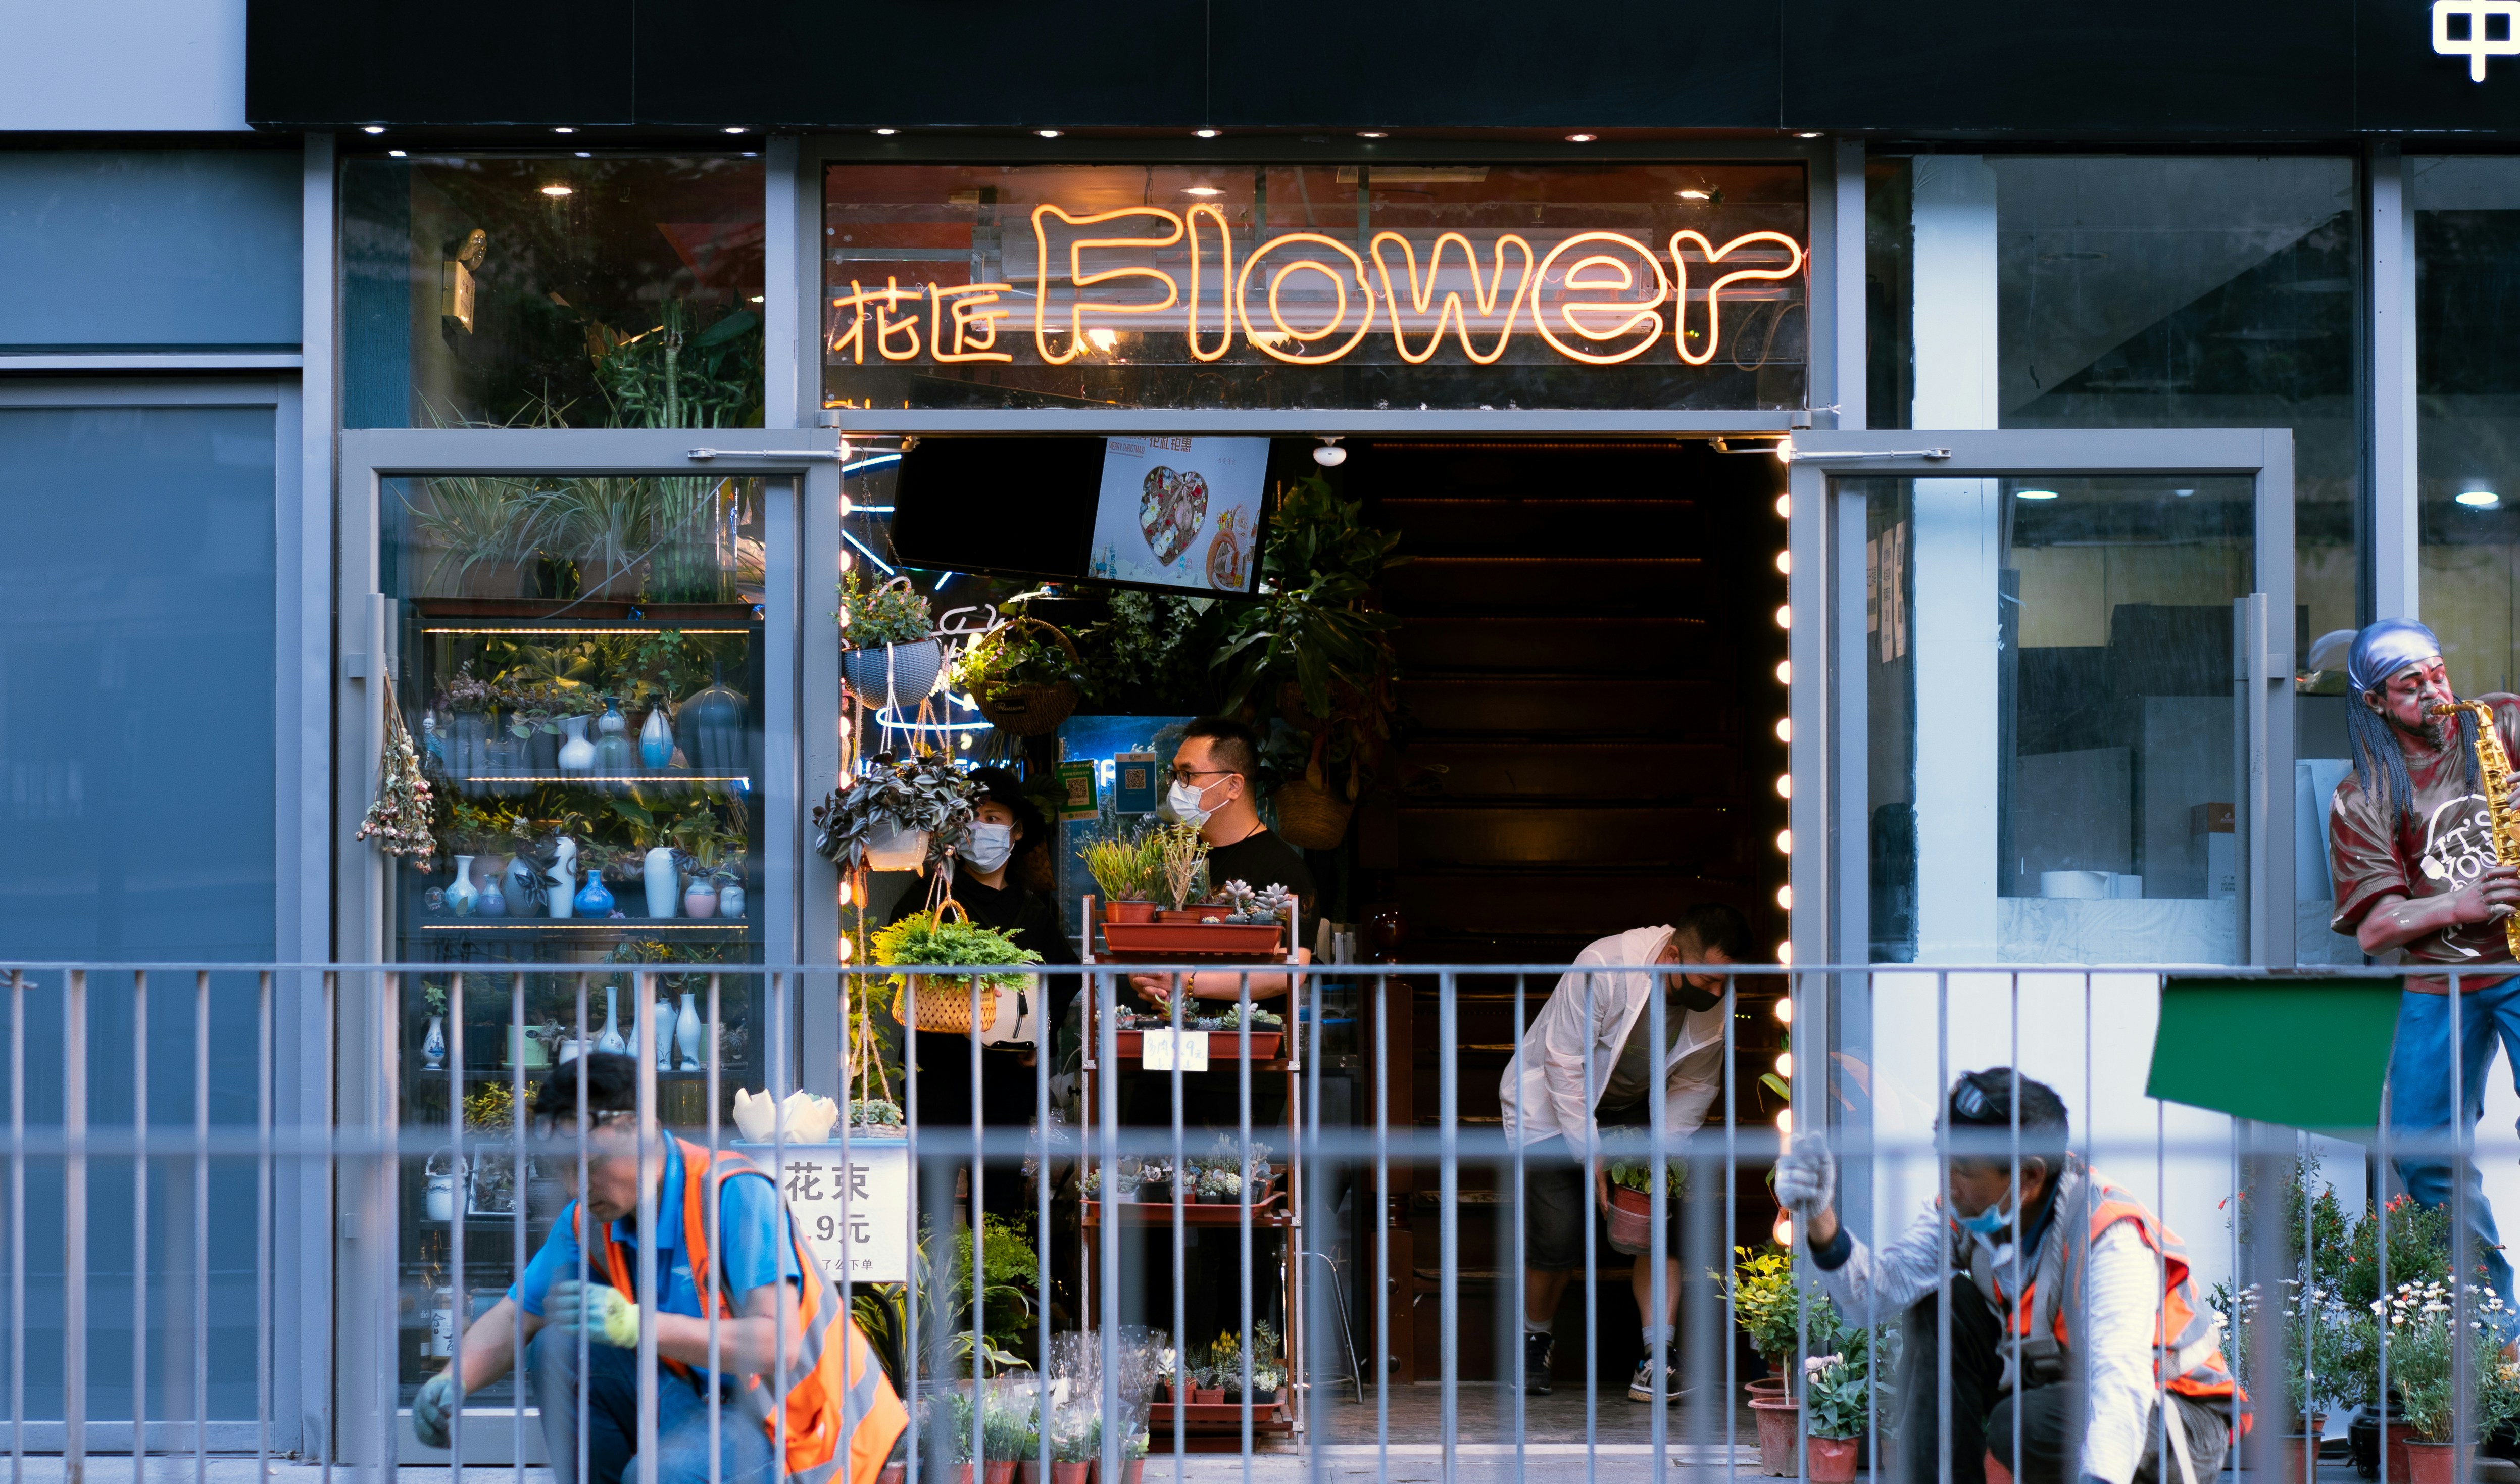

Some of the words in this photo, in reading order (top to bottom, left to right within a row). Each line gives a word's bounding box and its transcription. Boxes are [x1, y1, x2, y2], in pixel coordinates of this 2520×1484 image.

[2433, 0, 2520, 82] 中
[1031, 203, 1802, 366] Flower
[831, 276, 1013, 365] 花匠
[1109, 441, 1122, 451] MERRY
[1122, 443, 1145, 454] CHRISTMAS!
[994, 702, 1025, 712] Flowers
[1146, 1037, 1204, 1059] 多肉.9元
[784, 1161, 870, 1202] 花束
[794, 1214, 870, 1244] .9元
[822, 1259, 873, 1270] 了么下单
